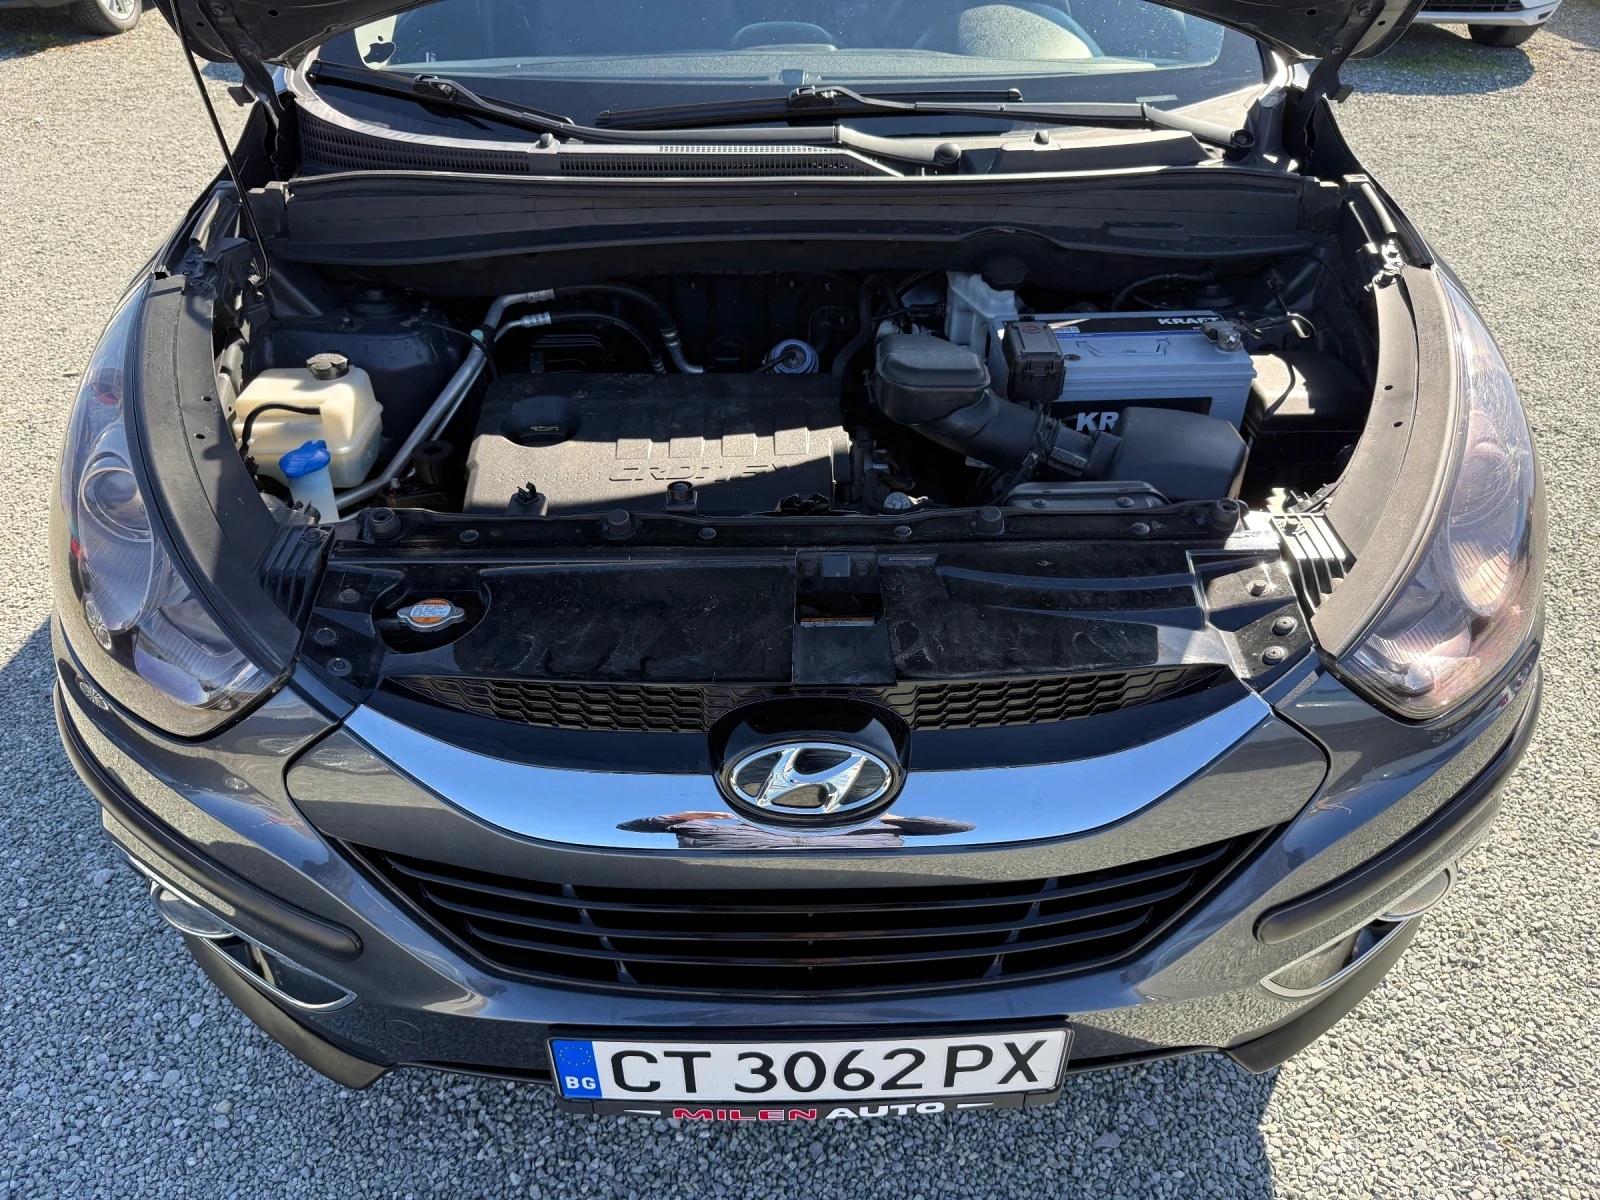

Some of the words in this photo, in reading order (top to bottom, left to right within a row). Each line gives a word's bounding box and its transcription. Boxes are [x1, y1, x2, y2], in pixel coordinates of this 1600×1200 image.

[1157, 317, 1219, 325] KRAFT
[611, 1050, 711, 1093] CT
[734, 1048, 926, 1093] 3062
[943, 1040, 1047, 1088] PX
[565, 1076, 596, 1089] BG
[672, 1107, 817, 1121] MILEN
[825, 1102, 945, 1119] AUTO
